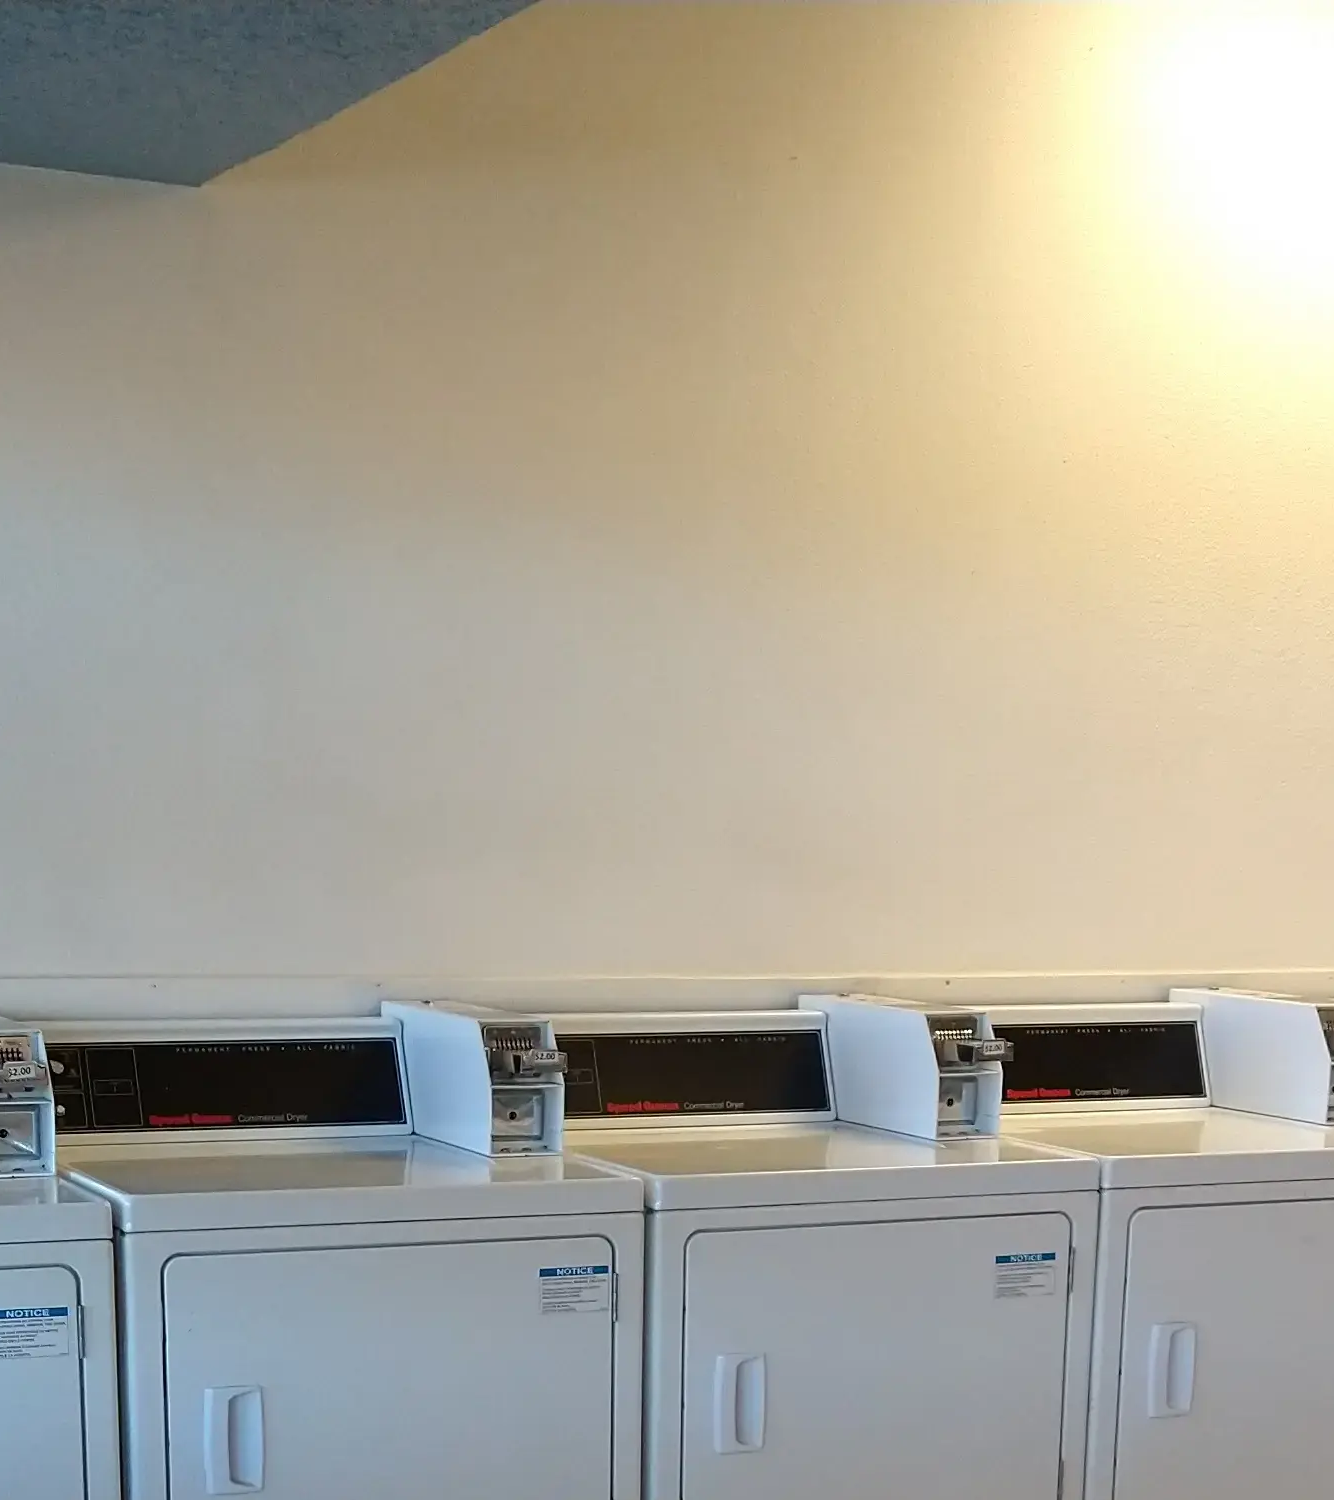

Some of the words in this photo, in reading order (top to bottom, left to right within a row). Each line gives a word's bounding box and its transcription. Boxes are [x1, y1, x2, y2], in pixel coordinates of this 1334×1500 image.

[8, 1066, 31, 1078] $2.00
[286, 1112, 308, 1122] Dryer
[1010, 1254, 1043, 1262] NOTICE
[556, 1267, 594, 1276] NOTICE
[5, 1308, 50, 1318] NOTICE
